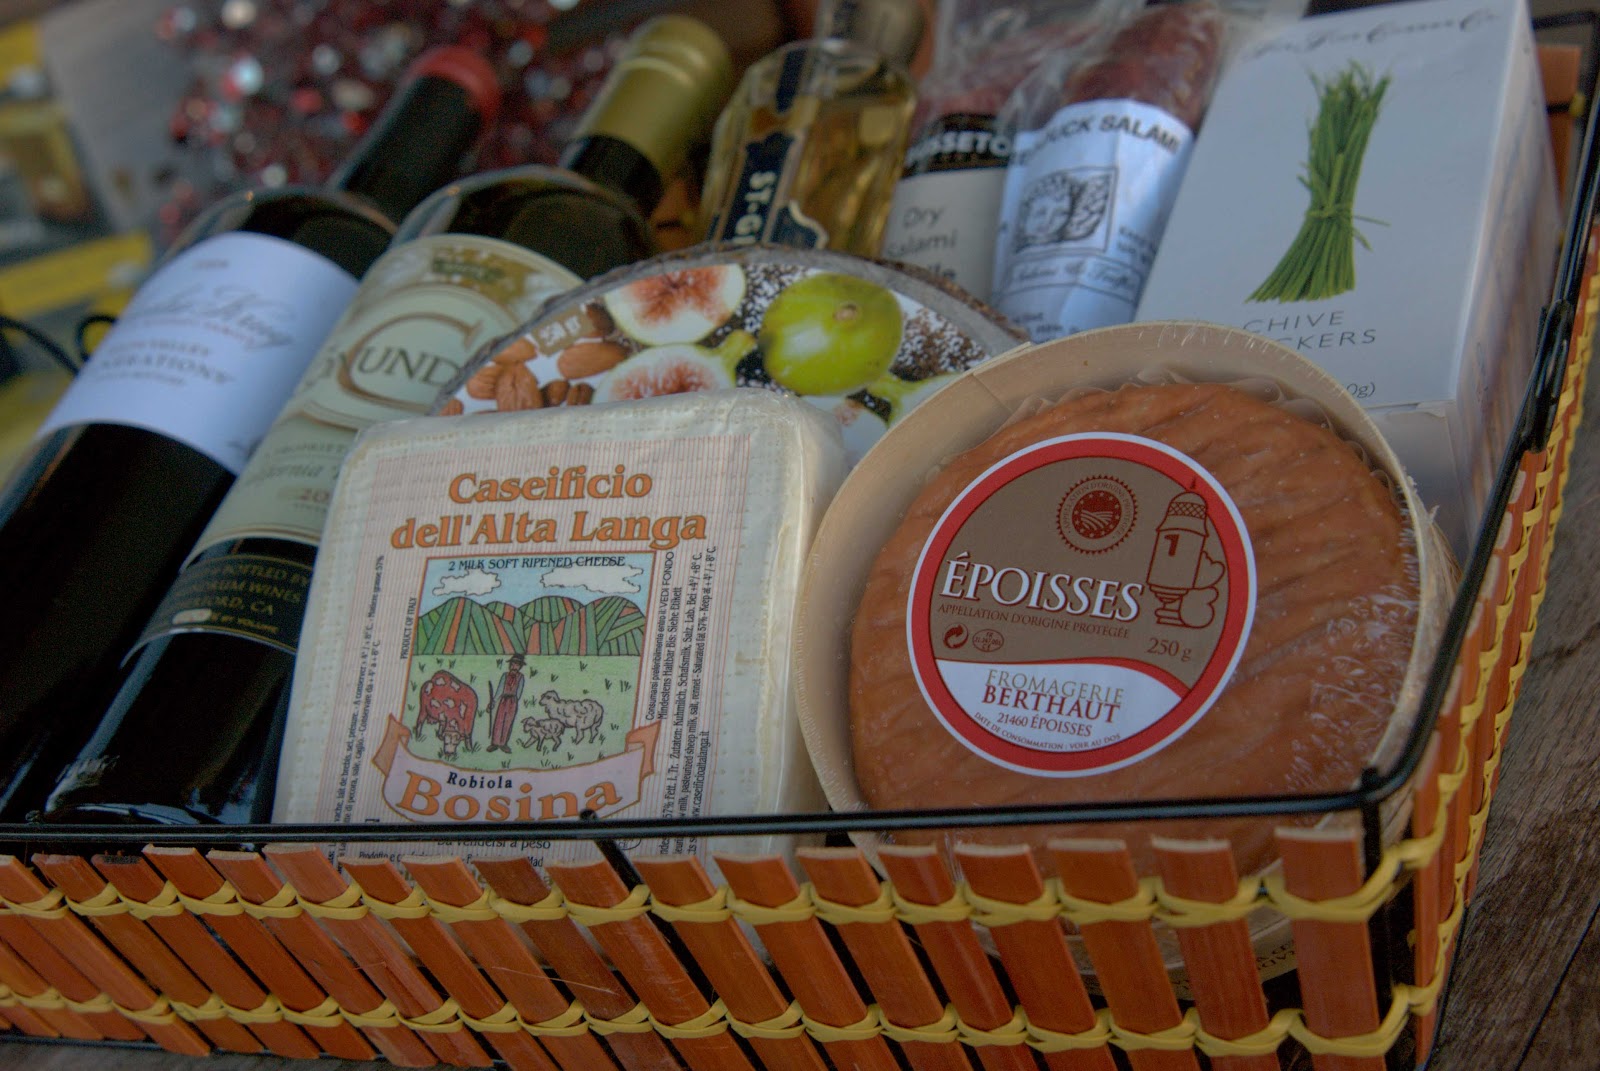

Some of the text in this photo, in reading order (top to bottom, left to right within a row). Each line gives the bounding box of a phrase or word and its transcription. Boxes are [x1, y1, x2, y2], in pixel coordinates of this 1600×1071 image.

[1243, 310, 1345, 333] CHIVE
[449, 464, 653, 504] Caseificio
[390, 511, 707, 550] dell'Alta Langa
[1163, 534, 1181, 557] 1
[448, 556, 625, 571] 2 MILK SOFT RIPENED CHEESE
[662, 552, 674, 585] FONDO
[660, 588, 670, 608] VEDI
[940, 551, 1146, 623] ÉPOISSES
[400, 597, 416, 659] PRODUCT OF ITALY
[938, 603, 1130, 639] APPELLATION D'ORIGINE PROTÉGÉE
[651, 634, 664, 680] preferibilmente
[657, 587, 682, 720] Mindestens Haltbar Bis: Siehe Etikett
[692, 643, 705, 673] Saturated
[1147, 638, 1192, 661] 250 g
[669, 728, 683, 759] Zutaten:
[687, 594, 696, 605] Bei
[691, 679, 702, 699] rennet
[986, 669, 1125, 706] FROMAGERIE
[645, 682, 658, 721] Consumarsi
[981, 684, 1121, 723] BERTHAUT
[974, 711, 1122, 750] DATE DE CONSOMMATION VOIR AU DOS
[997, 712, 1093, 737] 21460 ÉPOISSES
[685, 734, 696, 754] sheep
[340, 778, 347, 786] de
[447, 771, 513, 789] Robiola
[681, 756, 695, 793] pasteurized
[395, 770, 623, 822] Bosina
